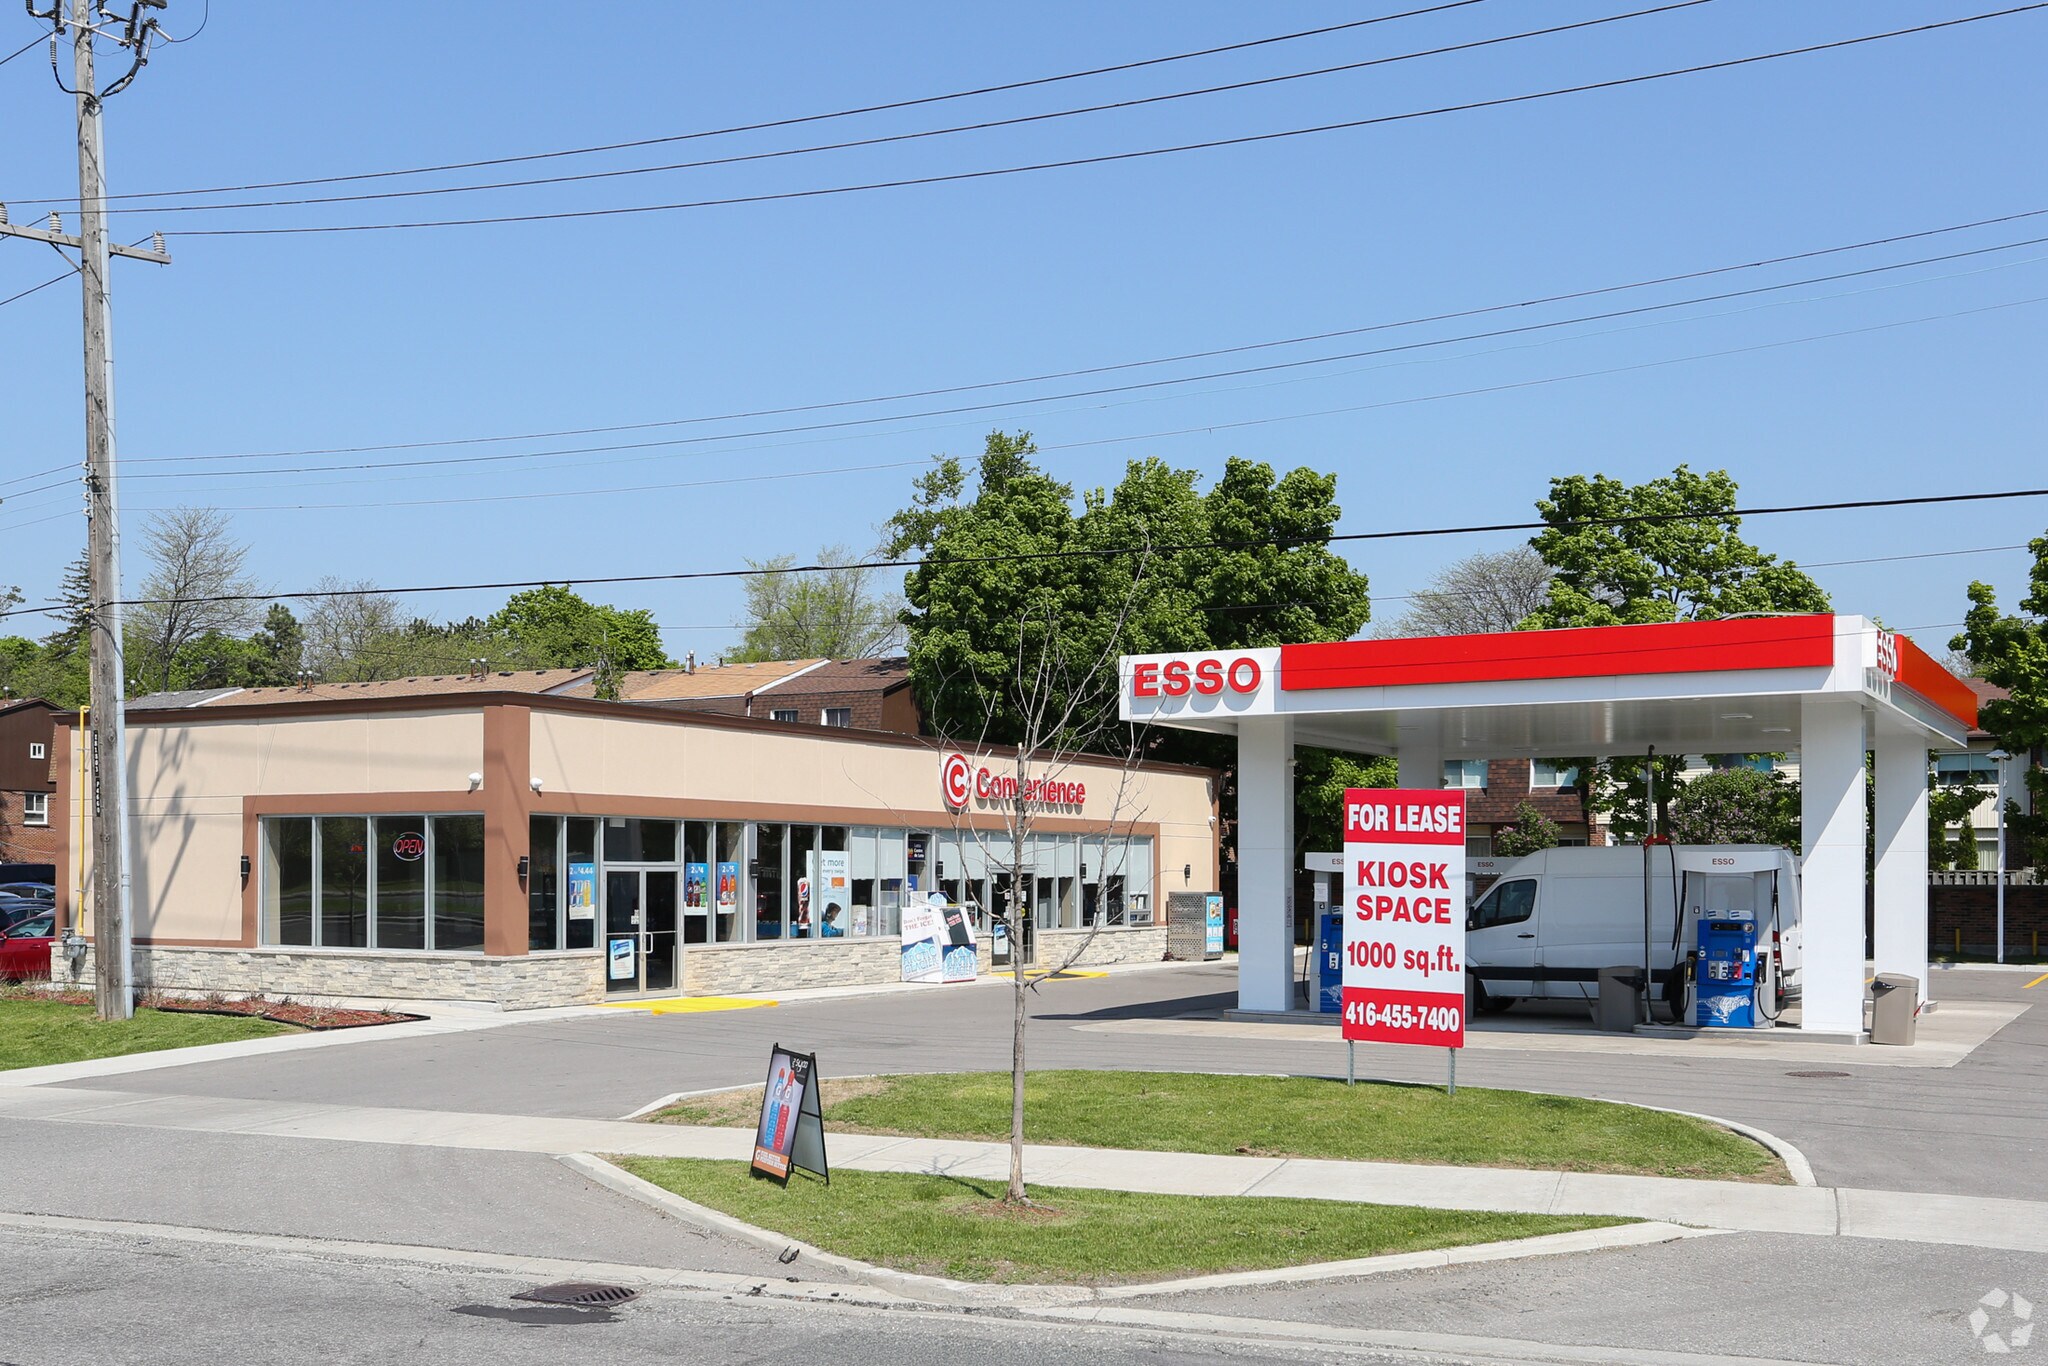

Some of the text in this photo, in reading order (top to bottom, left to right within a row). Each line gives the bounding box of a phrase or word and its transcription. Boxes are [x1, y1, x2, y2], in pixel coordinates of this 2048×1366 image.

[1877, 629, 1898, 675] ESSO
[1134, 657, 1261, 697] ESSO
[977, 767, 1086, 804] Convenience
[1348, 804, 1461, 833] FOR LEASE
[396, 840, 424, 853] OPEN
[1357, 861, 1449, 889] KIOSK
[1356, 895, 1451, 924] SPACE
[903, 946, 936, 964] ARCTIC
[905, 958, 939, 974] GLACIER
[1347, 941, 1460, 977] 1000 sq.ft.
[1345, 1001, 1460, 1032] 416-455-7400
[775, 1085, 782, 1096] G
[785, 1086, 791, 1098] G
